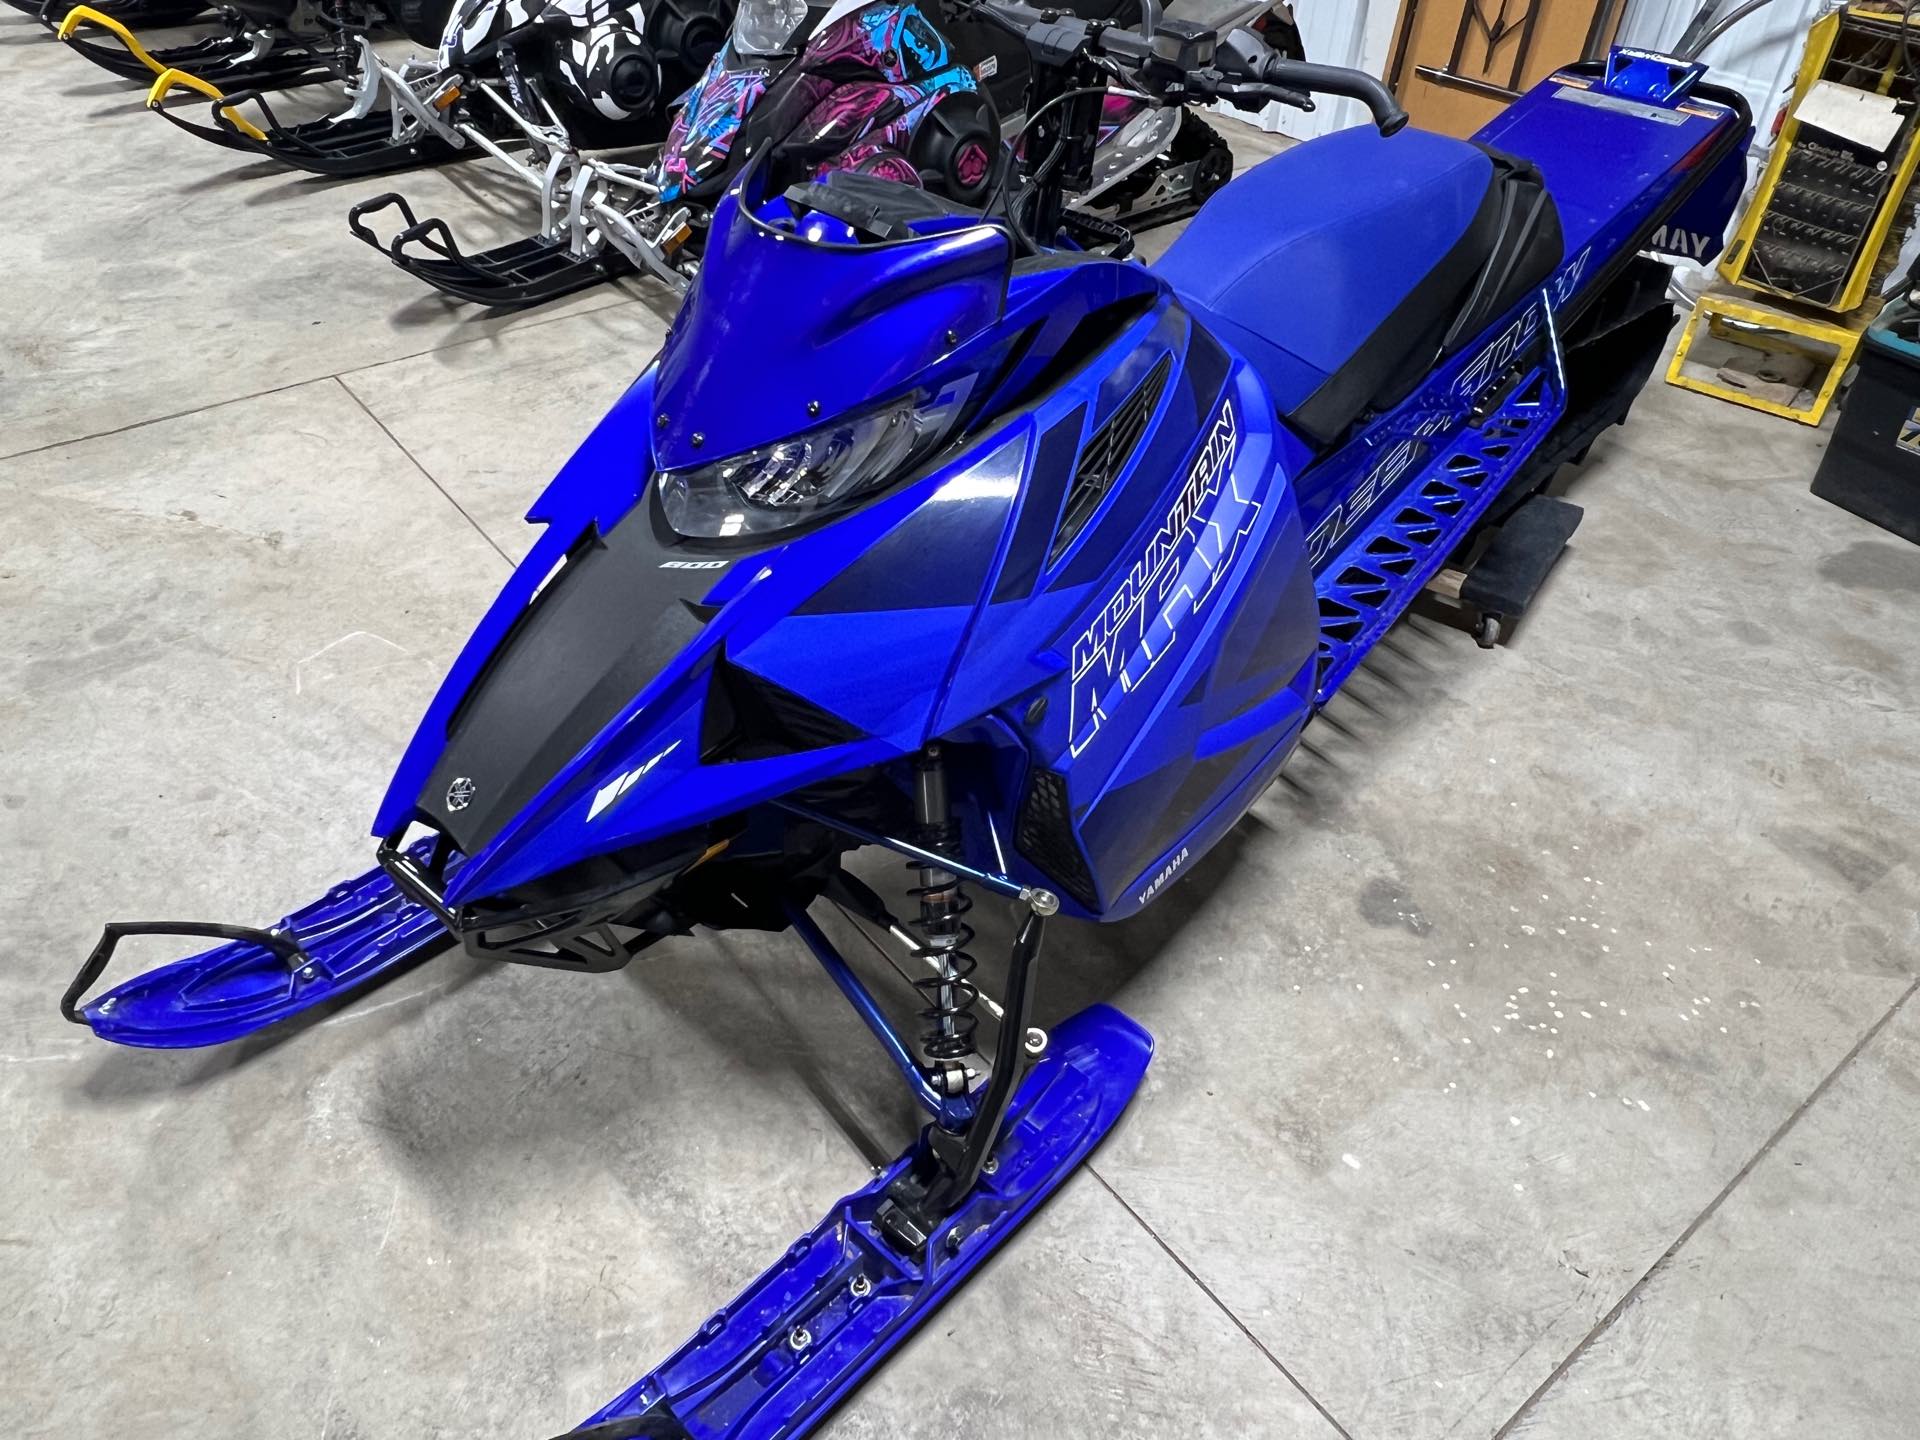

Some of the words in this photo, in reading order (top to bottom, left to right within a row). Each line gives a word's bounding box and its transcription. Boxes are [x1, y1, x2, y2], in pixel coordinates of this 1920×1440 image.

[1069, 434, 1261, 759] MAX
[1072, 399, 1236, 681] MOUNTAIN
[1138, 847, 1189, 904] YAMAHA
